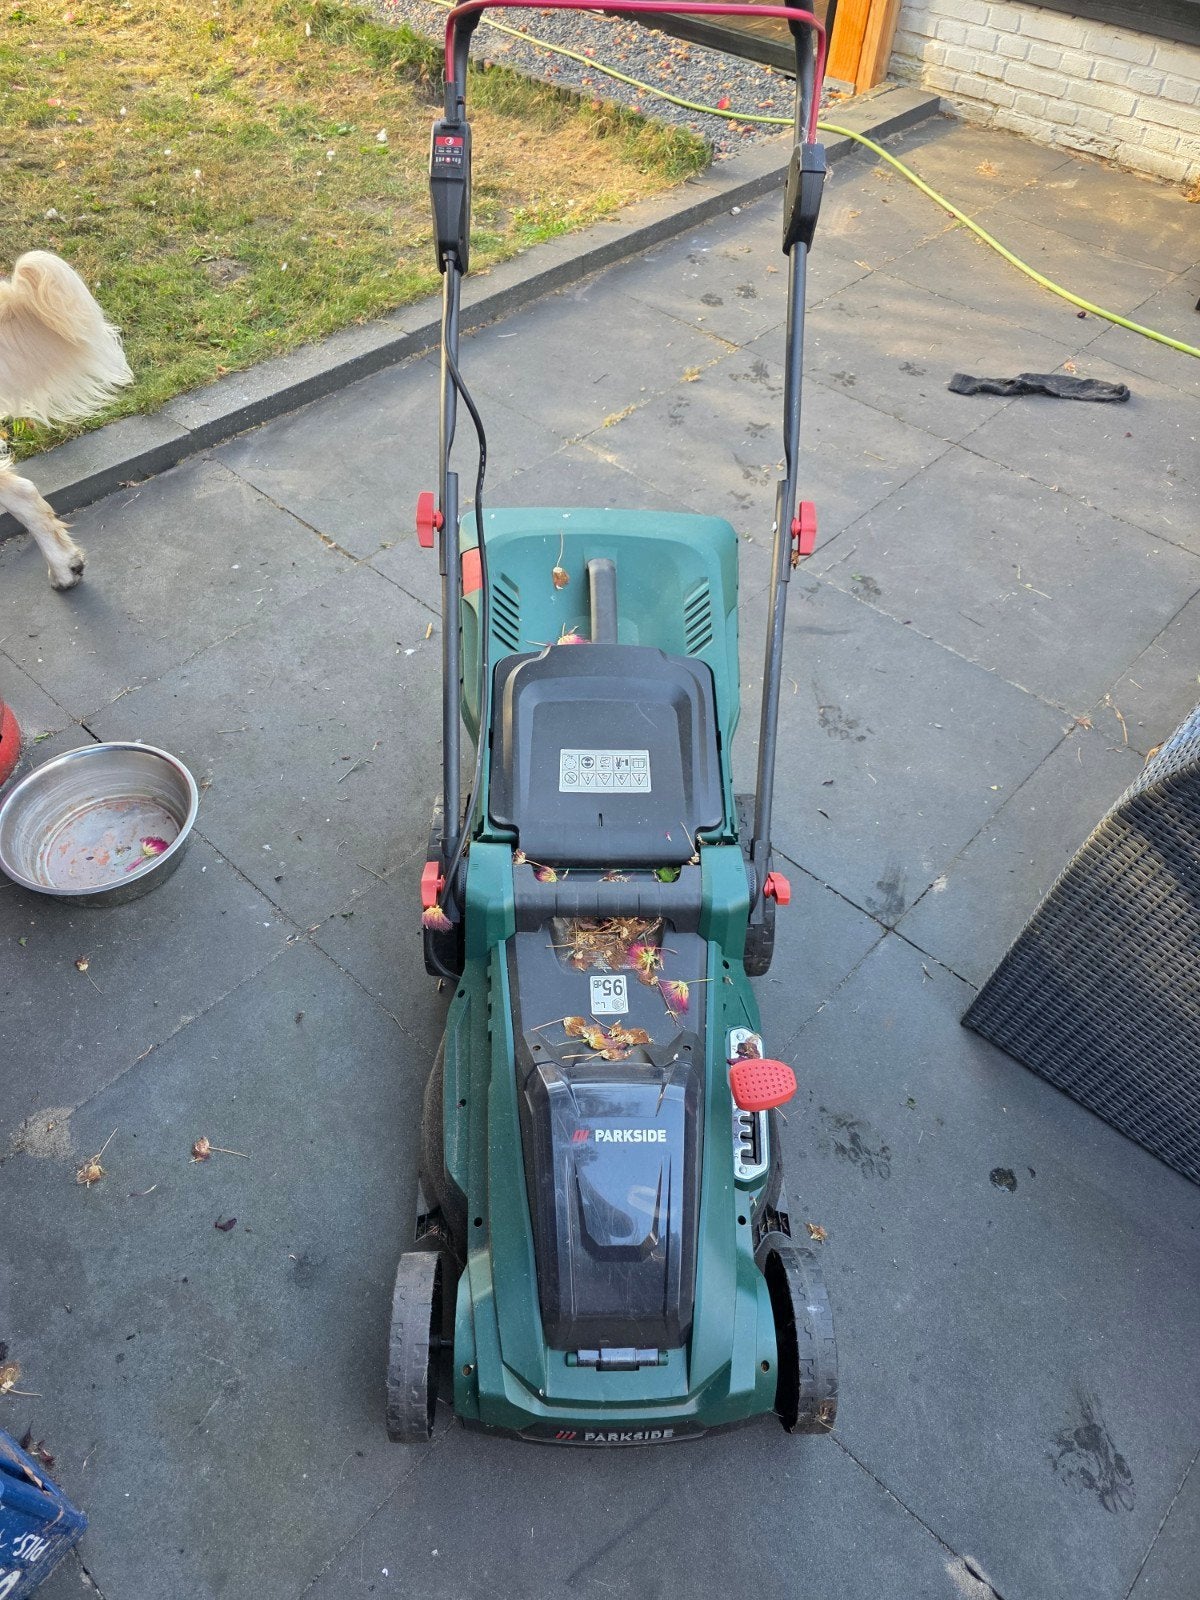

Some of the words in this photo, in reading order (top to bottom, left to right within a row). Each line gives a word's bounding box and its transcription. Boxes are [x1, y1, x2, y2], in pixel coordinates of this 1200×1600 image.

[595, 1129, 667, 1142] PARKSIDE
[584, 1429, 674, 1441] PARKSIDE
[12, 1533, 51, 1562] PILS
